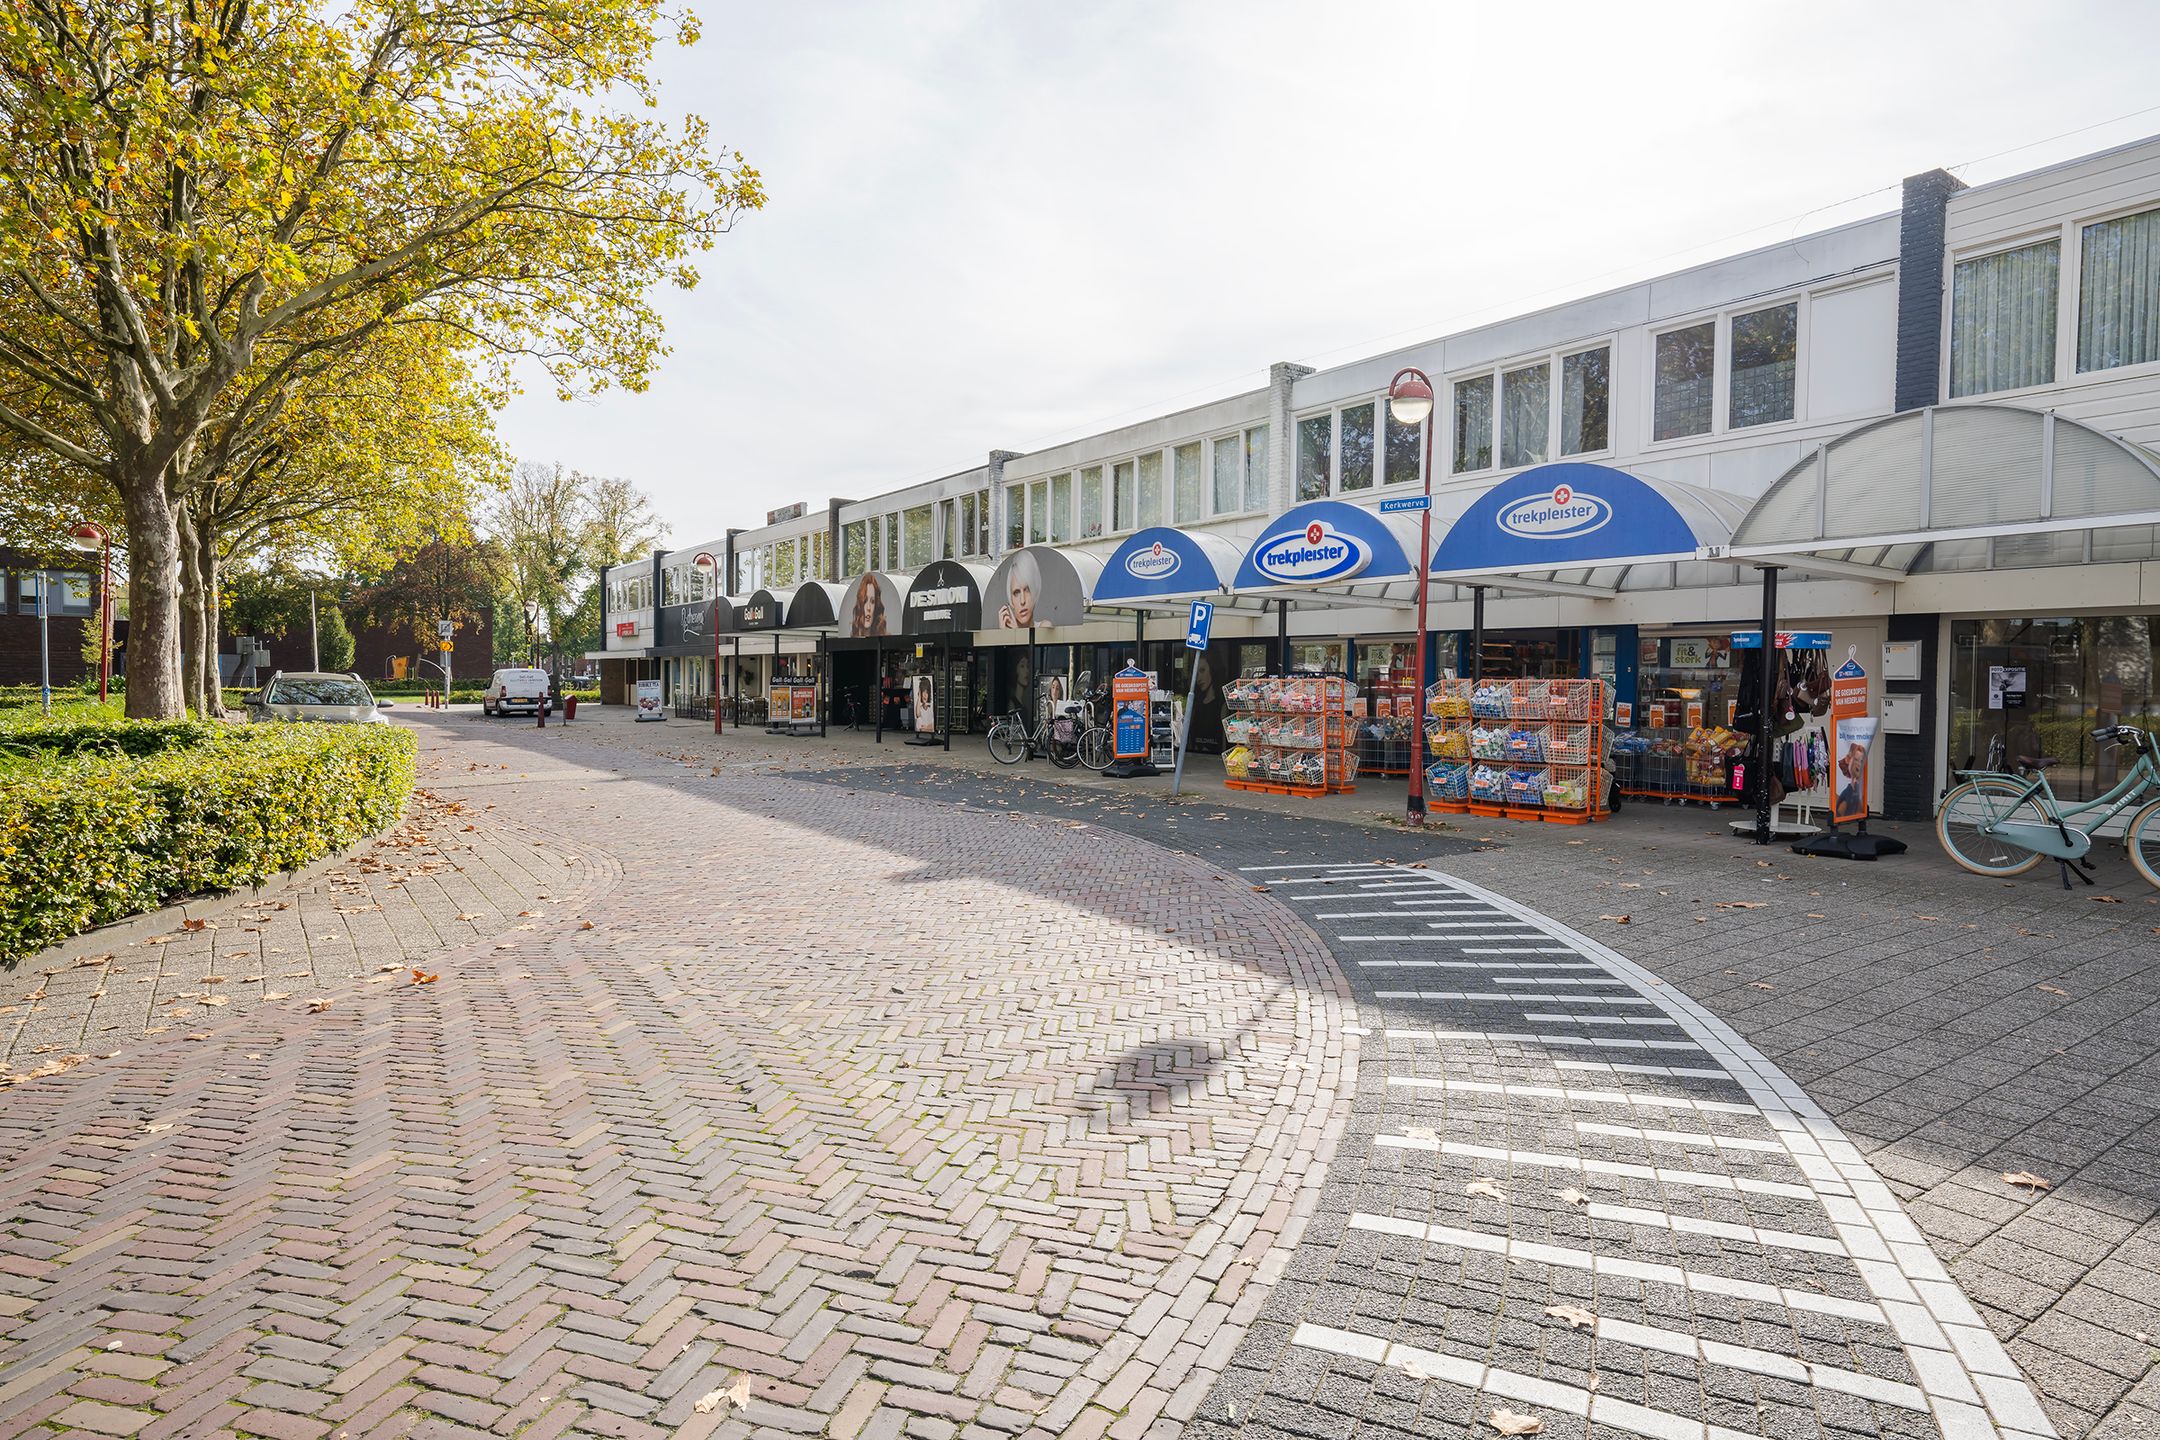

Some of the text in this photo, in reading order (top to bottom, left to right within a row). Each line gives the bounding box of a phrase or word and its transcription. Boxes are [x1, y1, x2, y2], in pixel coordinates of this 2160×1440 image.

[1384, 500, 1425, 510] Kerkwerve
[1511, 504, 1593, 525] trekpleister
[1132, 556, 1173, 569] trekpleister
[1266, 545, 1345, 567] trekpleister
[1192, 604, 1207, 629] P
[1835, 689, 1841, 697] DE
[1835, 696, 1866, 706] VAN NEDERLAND
[2105, 789, 2137, 816] SPIRIT
